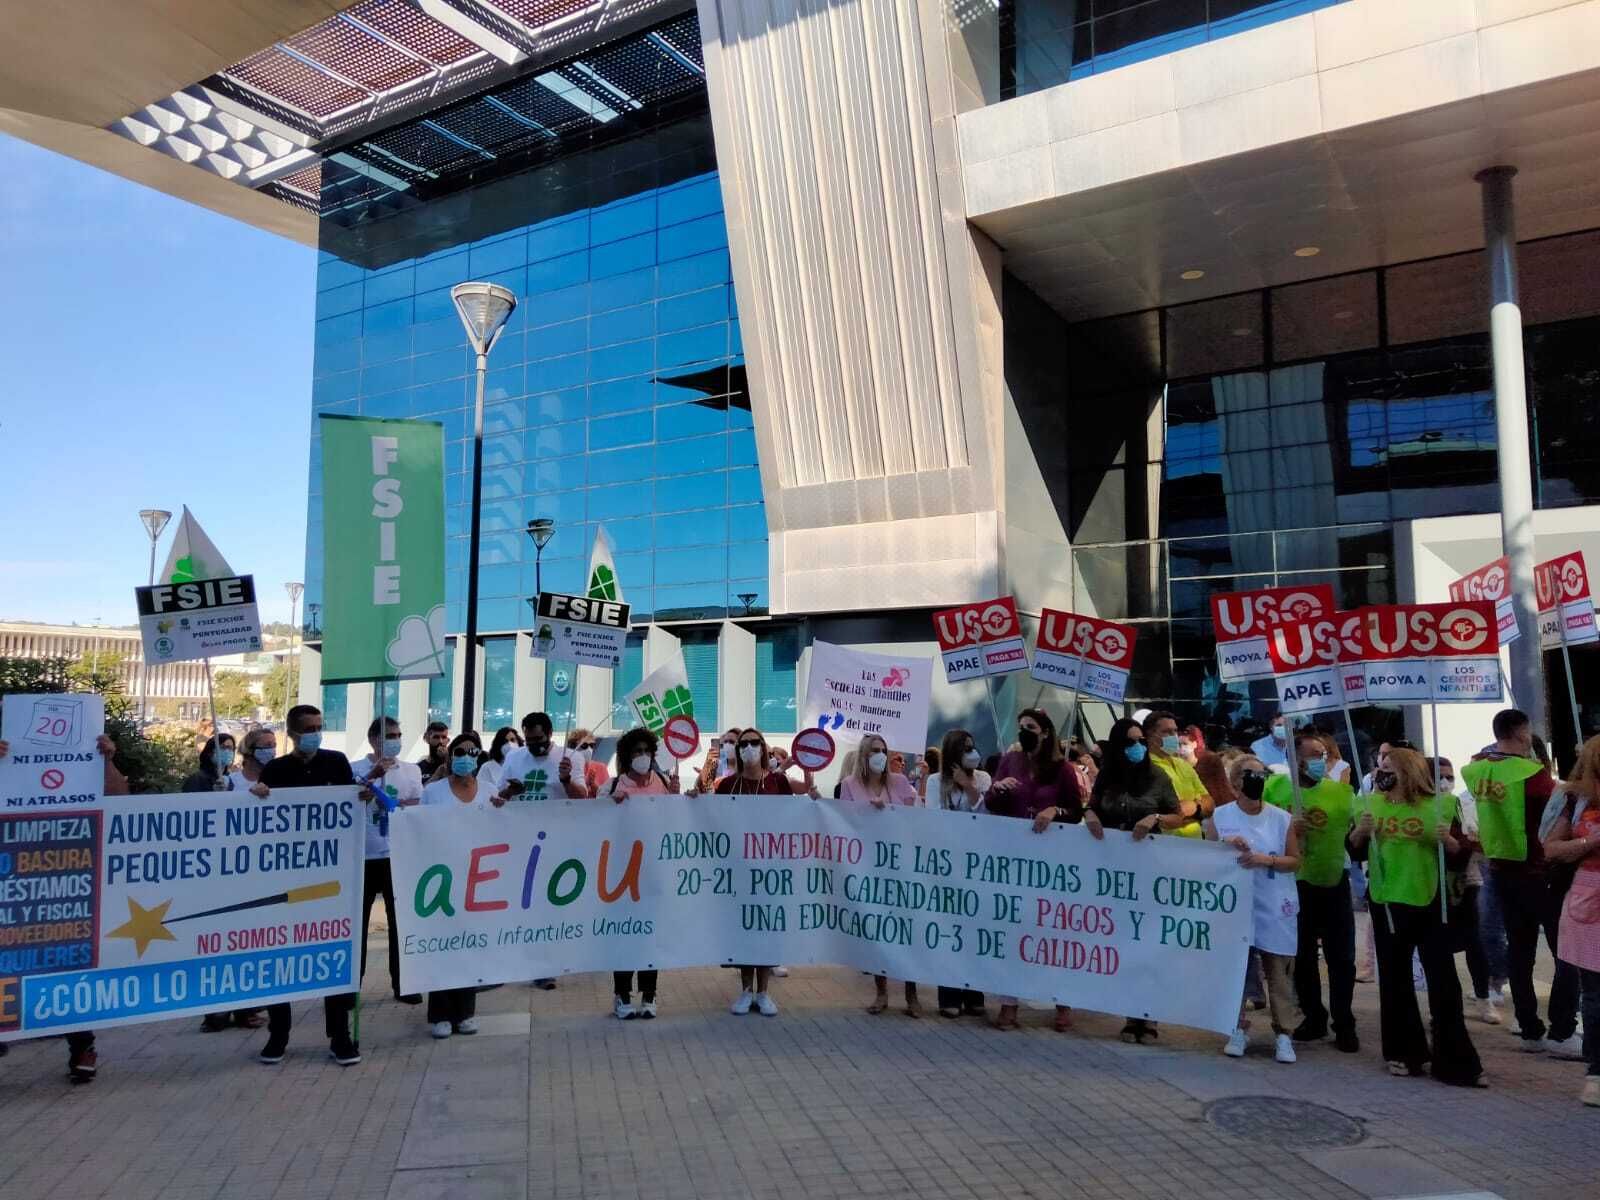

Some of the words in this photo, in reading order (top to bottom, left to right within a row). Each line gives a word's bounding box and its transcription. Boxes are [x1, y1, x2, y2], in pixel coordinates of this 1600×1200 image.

[371, 436, 403, 606] FSIE
[152, 579, 244, 612] FSIE
[549, 595, 622, 626] FSIE
[938, 604, 1012, 644] USO
[1045, 614, 1128, 661] USO
[1369, 609, 1488, 653] USO
[1542, 620, 1562, 636] APA
[949, 657, 979, 673] APAE
[1035, 661, 1066, 676] APOYA
[1069, 669, 1076, 678] A
[1224, 653, 1261, 665] APOYA
[1284, 681, 1332, 702] APAE
[1369, 675, 1412, 686] APOYA
[1416, 675, 1426, 685] A
[36, 717, 66, 737] 20
[846, 717, 860, 730] del
[13, 755, 29, 764] NI
[34, 753, 93, 764] DEUDAS
[6, 798, 24, 807] NI
[27, 793, 96, 806] ATRASOS
[3, 818, 92, 844] LIMPIEZA
[108, 811, 216, 844] AUNQUE
[225, 801, 353, 837] NUESTROS
[17, 848, 92, 872] BASURA
[107, 848, 211, 885] PEQUES
[220, 844, 251, 876] LO
[259, 839, 339, 871] CREAN
[658, 832, 730, 860] ABONO
[743, 831, 862, 863] INMEDIATO
[875, 841, 902, 869] DE
[914, 845, 952, 876] LAS
[966, 852, 1081, 893] PARTIDAS
[1096, 868, 1138, 900] DEL
[1153, 876, 1237, 914] CURSO
[22, 906, 32, 922] Y
[37, 902, 92, 921] FISCAL
[677, 868, 737, 898] 20-21,
[750, 869, 792, 896] POR
[807, 867, 834, 896] UN
[844, 873, 979, 917] CALENDARIO
[993, 895, 1022, 924] DE
[1036, 898, 1115, 936] PAGOS
[1128, 910, 1146, 941] Y
[1160, 915, 1212, 951] POR
[197, 932, 223, 956] NO
[227, 925, 287, 951] SOMOS
[293, 918, 351, 945] MAGOS
[403, 930, 488, 956] Escuelas
[498, 920, 584, 946] Infantiles
[592, 917, 654, 937] Unidas
[741, 903, 787, 931] UNA
[799, 903, 913, 946] EDUCACIÓN
[925, 921, 963, 953] 0-3
[977, 928, 1007, 959] DE
[1018, 934, 1120, 977] CALIDAD
[34, 973, 140, 1021] ¿CÓMO
[153, 968, 188, 1005] LO
[200, 949, 347, 1000] HACEMOS?
